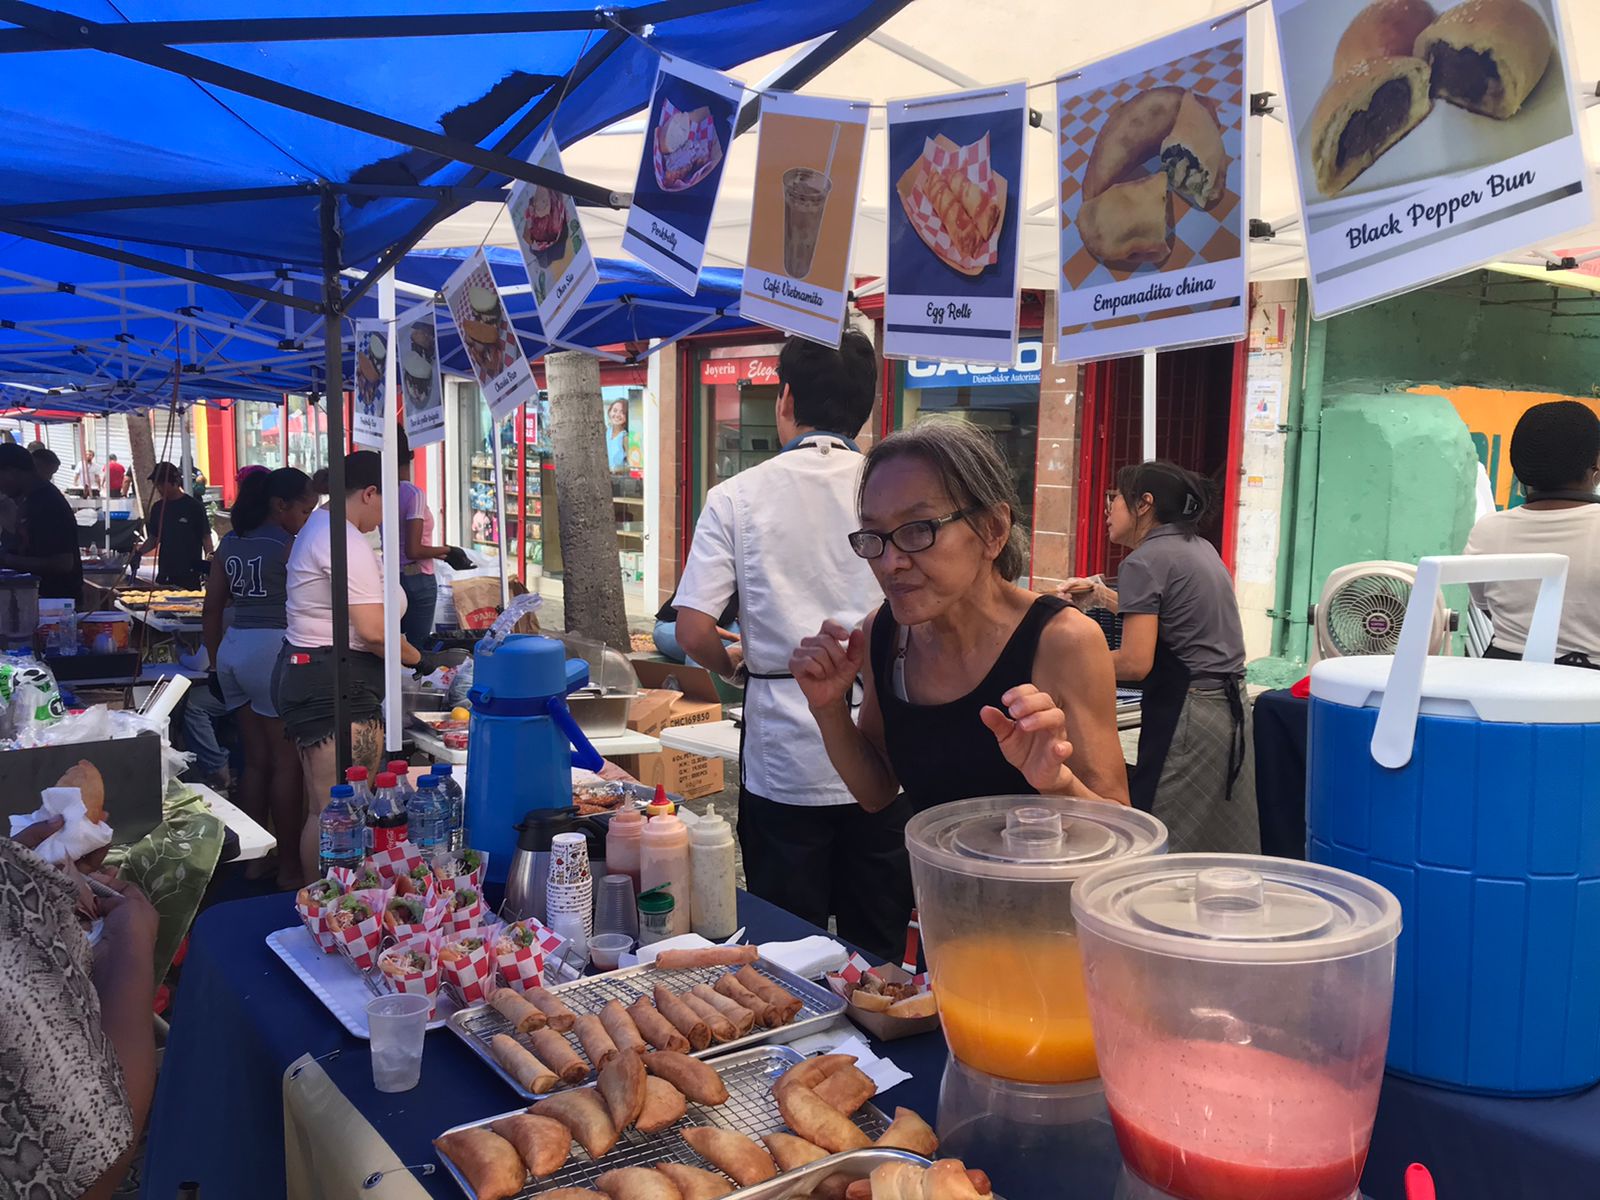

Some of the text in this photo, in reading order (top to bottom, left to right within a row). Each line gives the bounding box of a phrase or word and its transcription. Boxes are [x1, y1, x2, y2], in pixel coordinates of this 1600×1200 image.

[1345, 166, 1536, 250] Black Pepper Bun
[763, 277, 824, 308] Café Vietnamita
[1092, 275, 1216, 315] Empanadita china
[926, 302, 972, 324] Egg Rolls
[704, 362, 736, 377] Joyeria
[972, 373, 1010, 384] Distribuidor
[225, 555, 268, 597] 21
[670, 712, 710, 727] CHC169850
